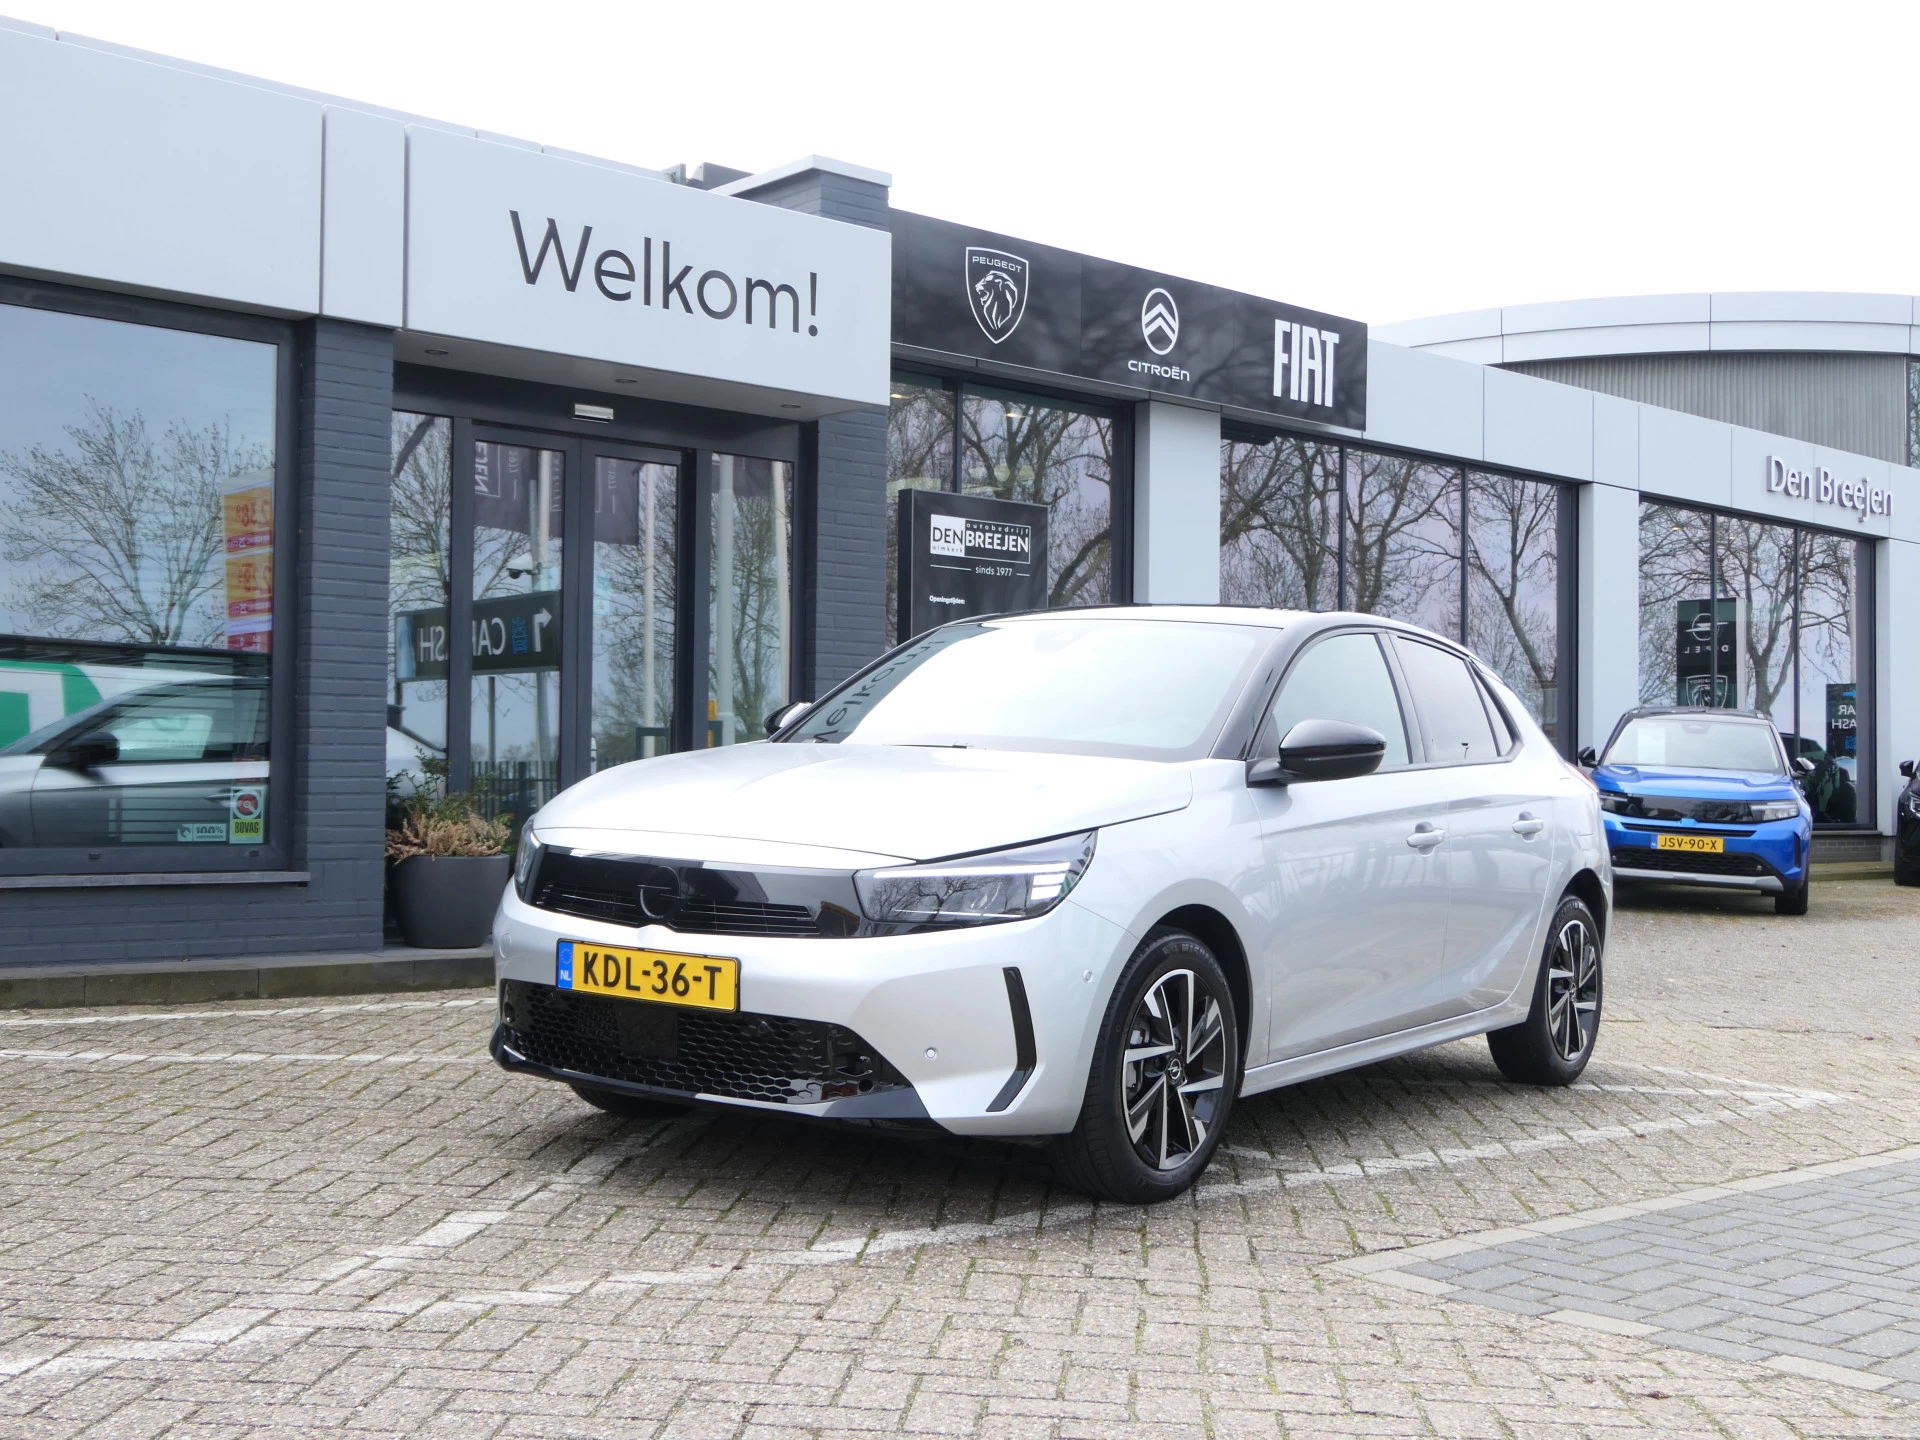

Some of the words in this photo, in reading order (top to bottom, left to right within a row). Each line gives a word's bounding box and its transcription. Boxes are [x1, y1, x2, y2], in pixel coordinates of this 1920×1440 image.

[509, 209, 818, 337] Welkom!
[972, 256, 1022, 272] PEUGEOT
[1127, 360, 1190, 382] CITROËN
[1273, 318, 1339, 407] FIAT
[1766, 455, 1812, 500] Den
[1815, 466, 1893, 522] Breejen
[966, 522, 1029, 535] autobedrijf
[932, 526, 963, 545] DEN
[965, 530, 1029, 553] BREEJEN
[975, 564, 995, 576] sinds
[996, 566, 1013, 577] 1977
[234, 821, 260, 834] BOVAG
[1660, 837, 1717, 851] JSV-90-X
[560, 969, 572, 981] NL
[583, 951, 722, 1001] KDL-36-T
